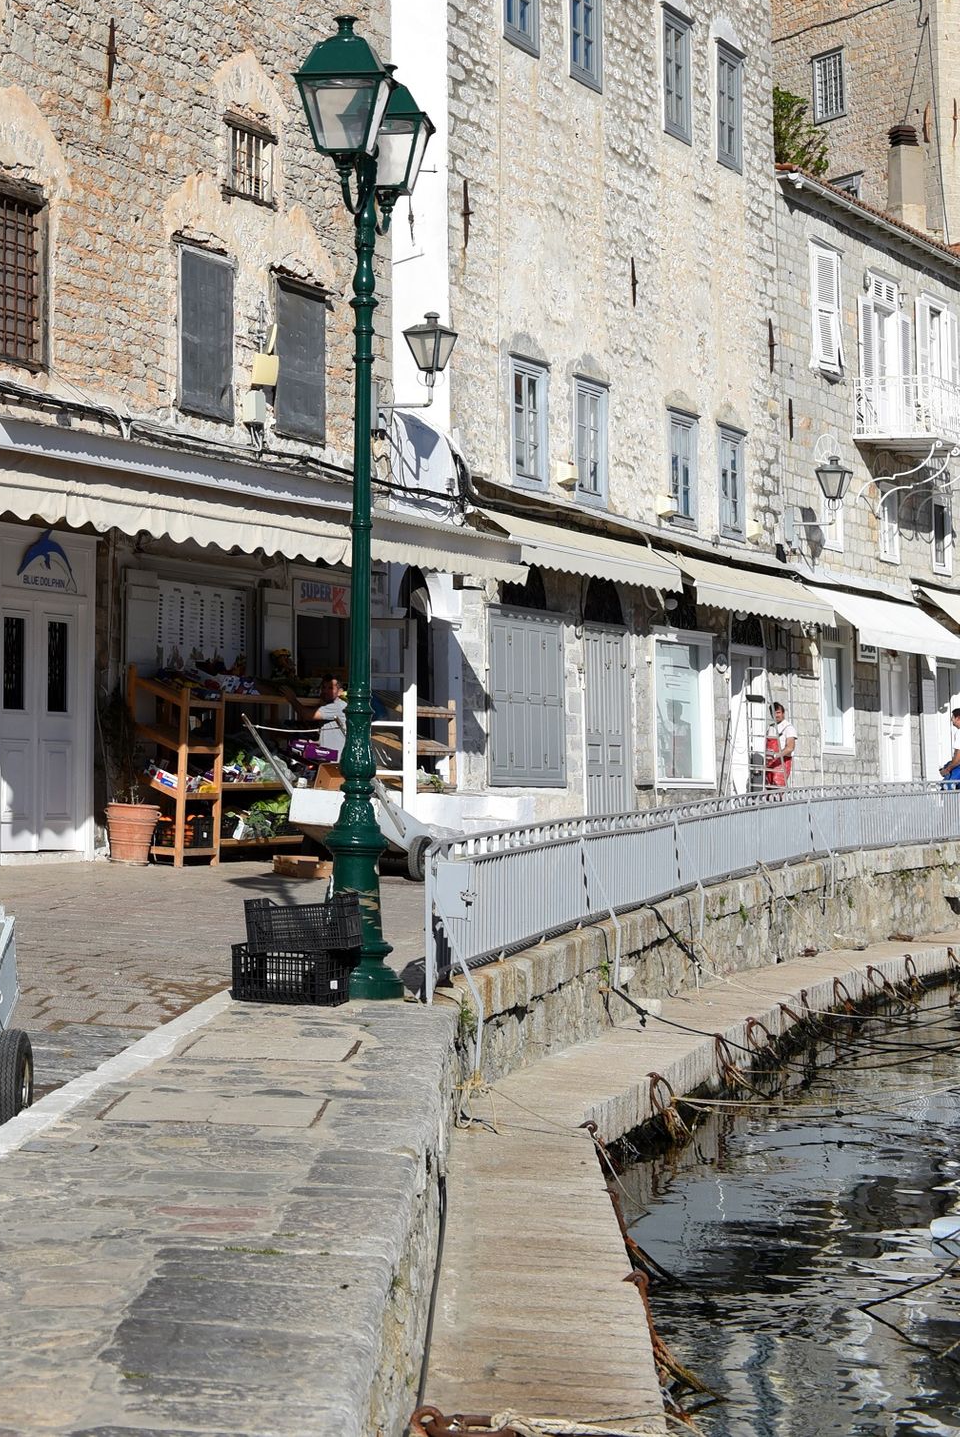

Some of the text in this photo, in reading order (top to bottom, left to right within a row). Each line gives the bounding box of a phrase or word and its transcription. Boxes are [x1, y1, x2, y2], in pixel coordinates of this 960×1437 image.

[23, 574, 65, 588] BLUE DOLPHIN
[300, 582, 332, 602] SUPER
